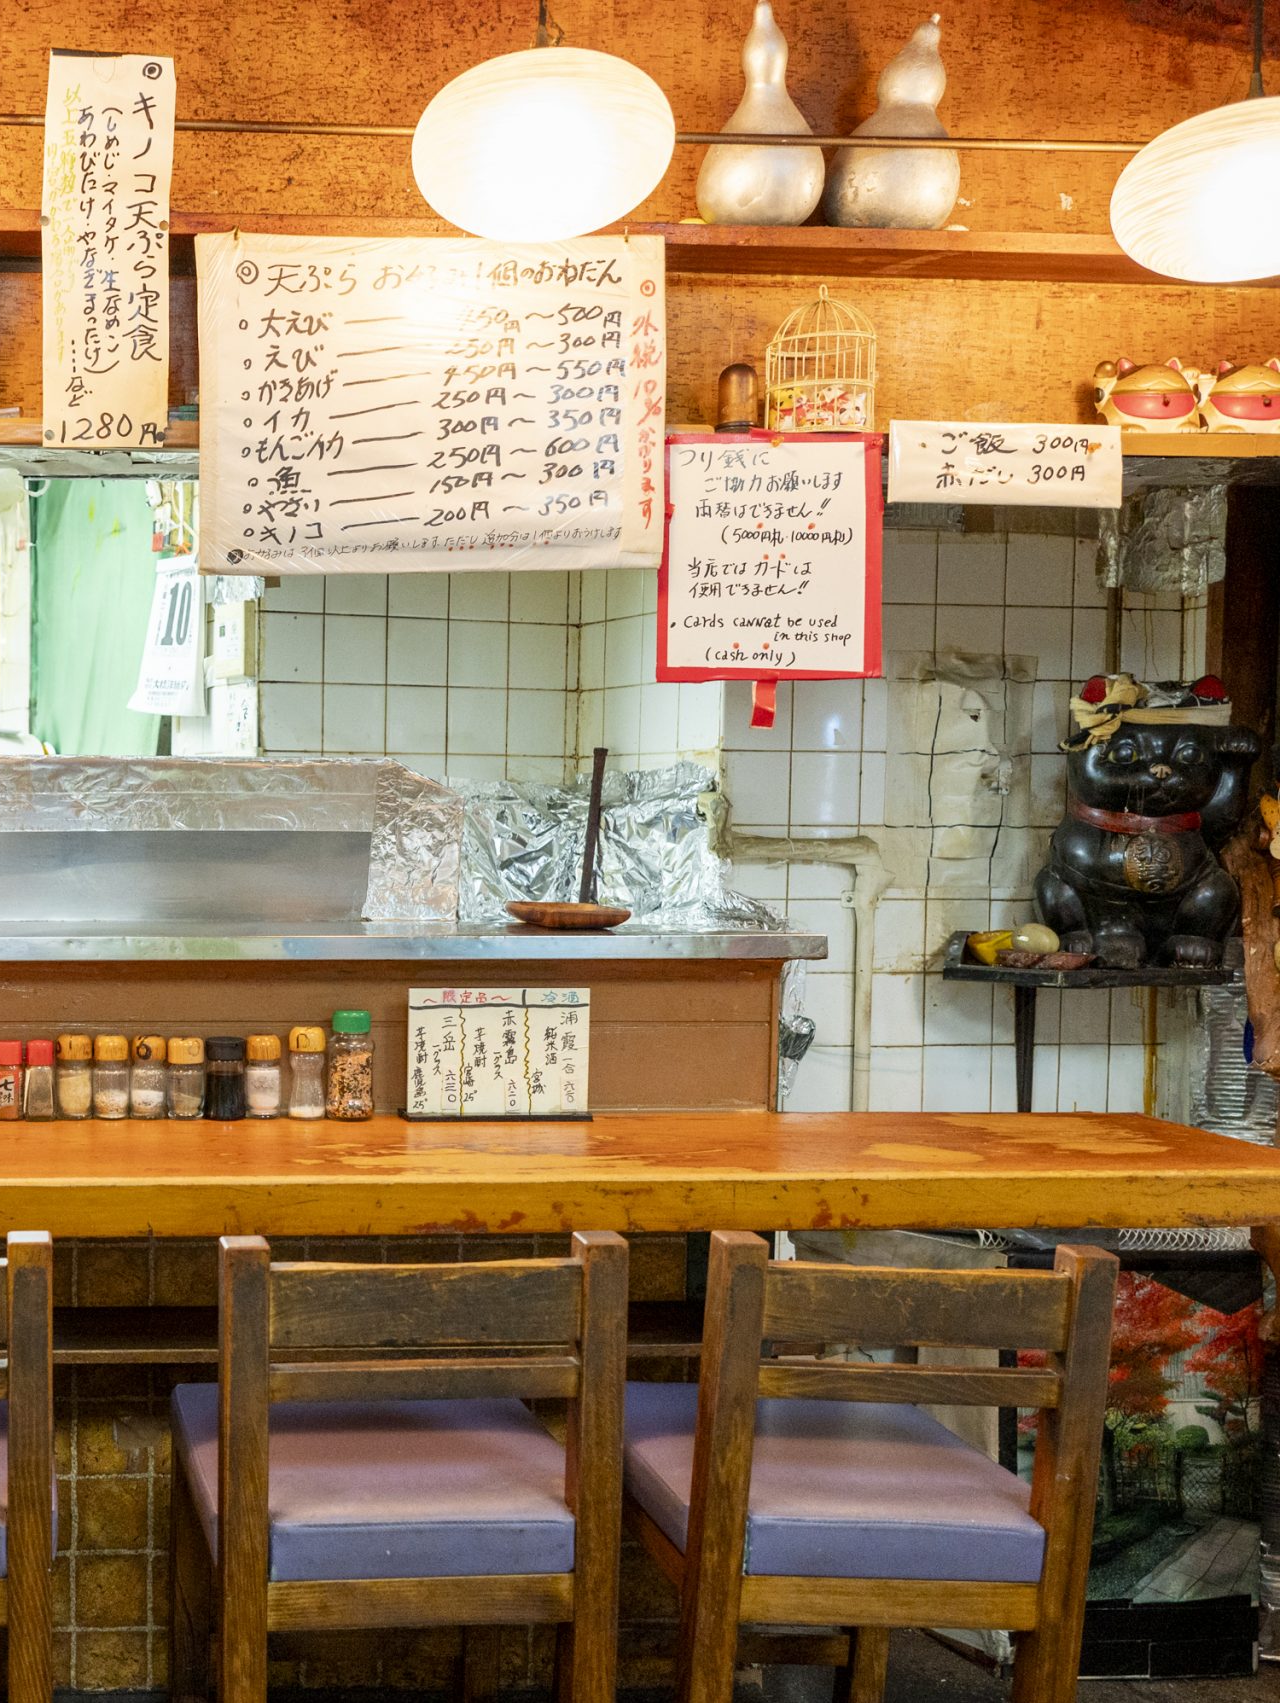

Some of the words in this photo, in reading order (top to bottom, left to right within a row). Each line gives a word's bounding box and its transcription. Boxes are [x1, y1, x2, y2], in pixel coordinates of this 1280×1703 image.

[123, 92, 164, 361] キノコ天ぷら定食
[258, 308, 334, 339] 大えび
[265, 344, 325, 373] えび
[259, 369, 338, 406] かきあげ
[61, 413, 158, 446] 1280円
[264, 407, 310, 433] イカ
[940, 431, 1018, 455] ご飯
[1032, 433, 1090, 456] 300円
[679, 448, 770, 472] つり銭に
[267, 466, 312, 495] 魚
[704, 470, 843, 493] ご協力お願いします
[1027, 464, 1086, 485] 300円
[260, 522, 323, 545] キノコ
[160, 581, 192, 646] 10
[683, 613, 725, 629] Cards
[787, 614, 802, 628] be
[808, 614, 838, 628] used
[773, 629, 791, 642] in
[794, 628, 818, 643] this
[824, 631, 852, 647] shop
